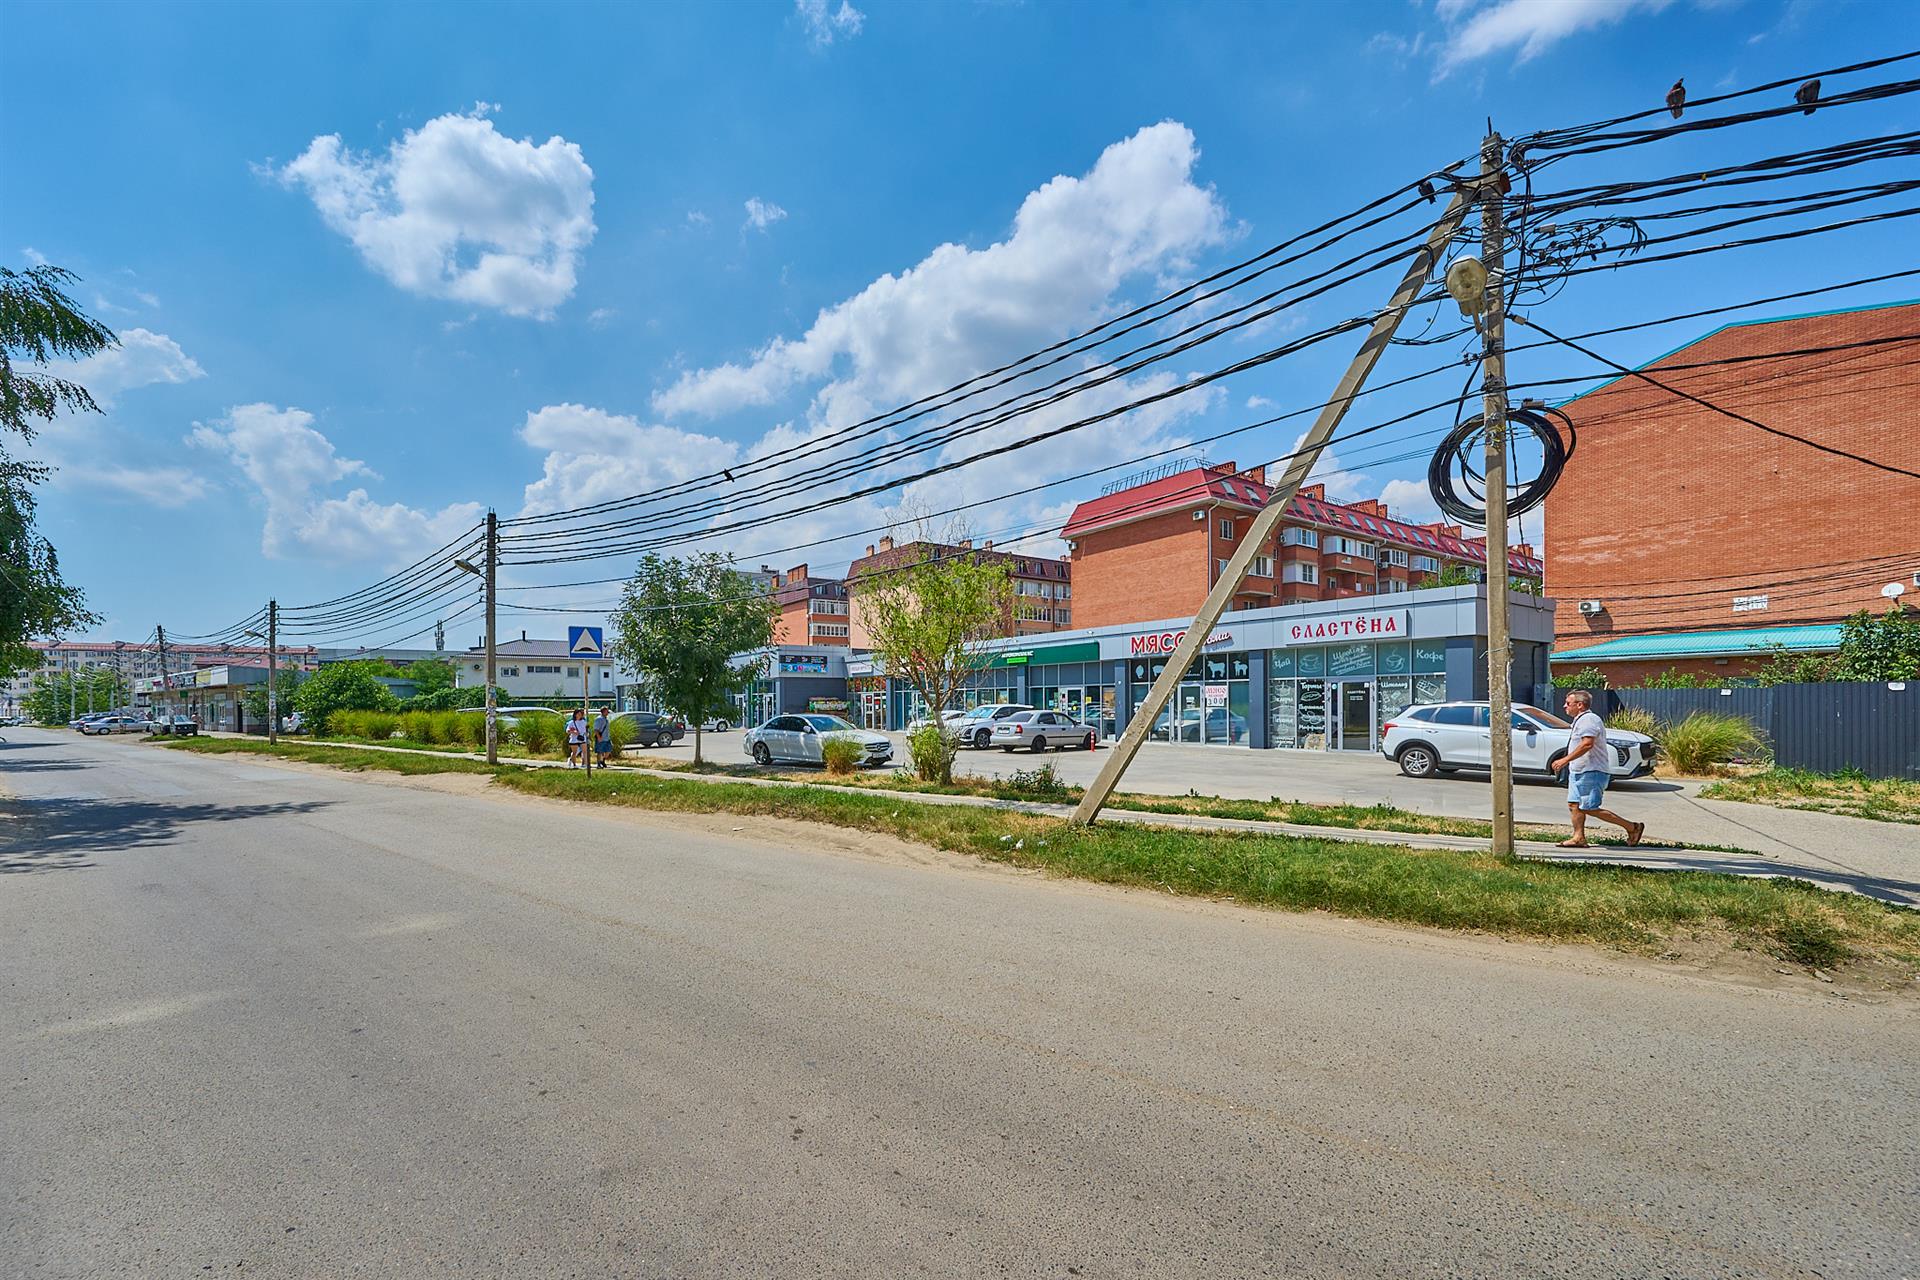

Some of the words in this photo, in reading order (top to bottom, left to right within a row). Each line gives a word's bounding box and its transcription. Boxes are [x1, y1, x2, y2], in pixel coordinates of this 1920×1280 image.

[1291, 616, 1397, 639] СЛАСТЁНА
[1416, 649, 1445, 662] Кофе
[1274, 658, 1291, 669] Чай
